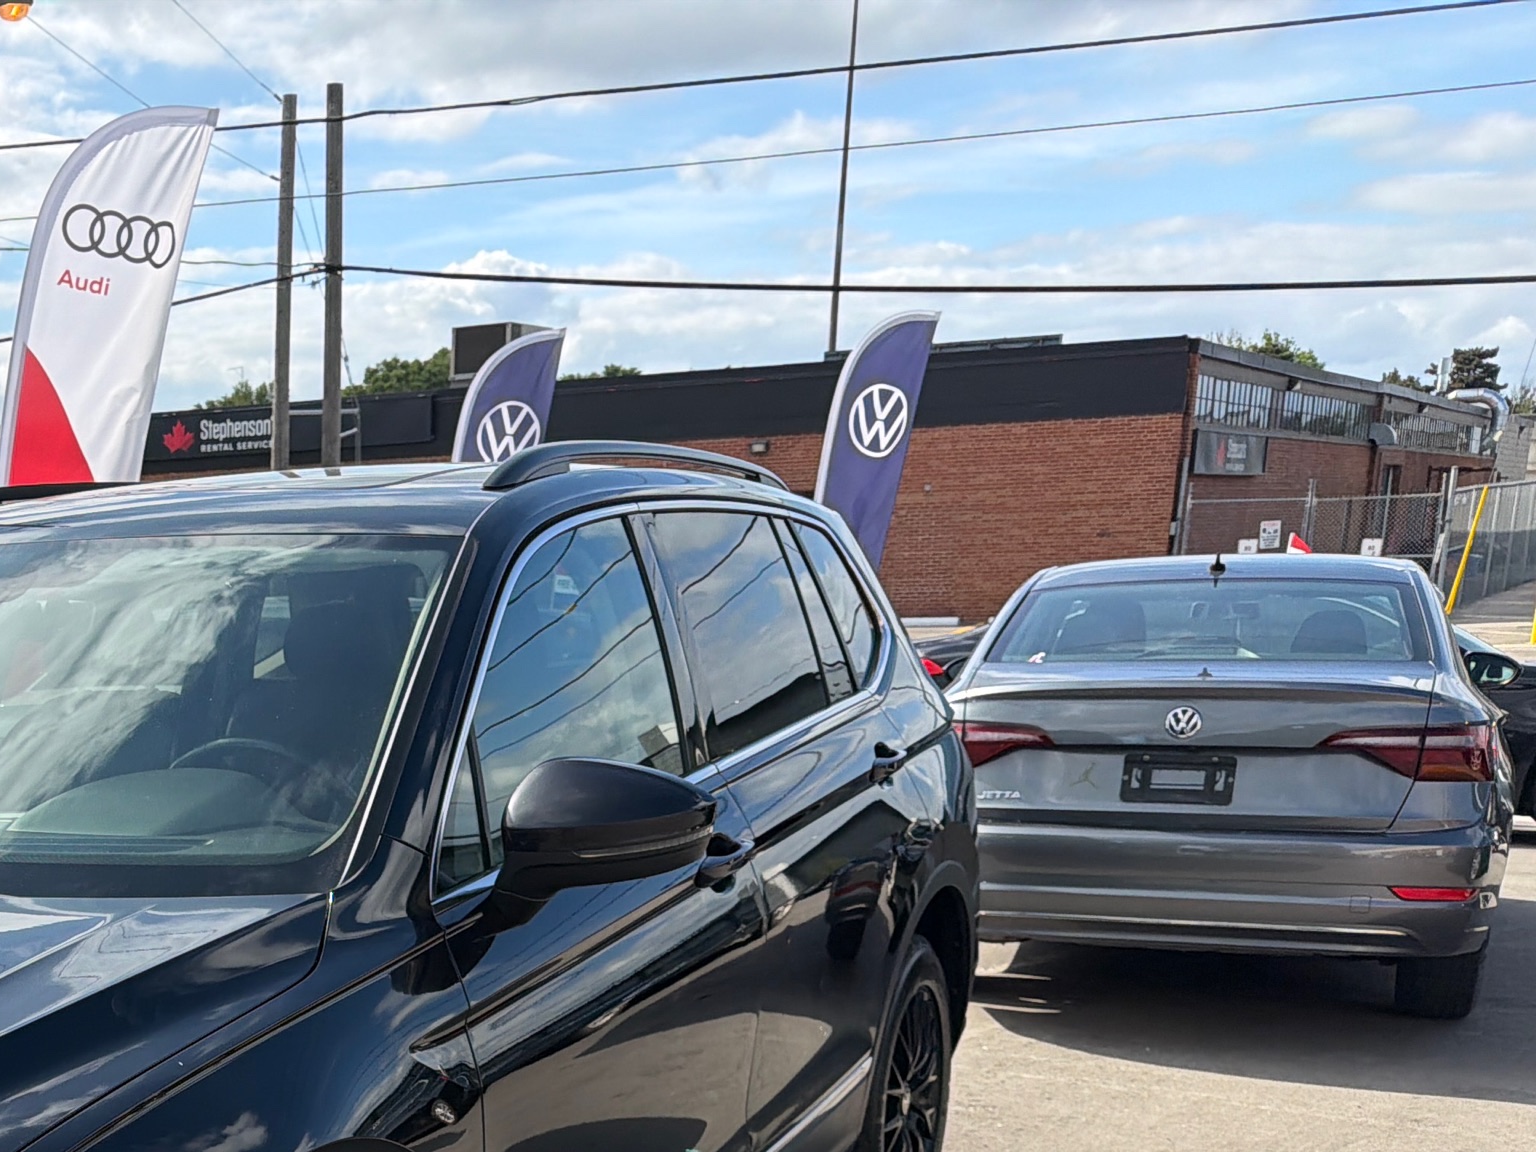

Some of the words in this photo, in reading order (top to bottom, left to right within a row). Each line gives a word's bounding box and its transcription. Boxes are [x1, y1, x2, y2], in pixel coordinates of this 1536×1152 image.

[56, 269, 111, 296] Audi
[199, 418, 274, 441] Stephenson'
[200, 443, 234, 452] RENTAL
[976, 790, 1021, 800] JETTA
